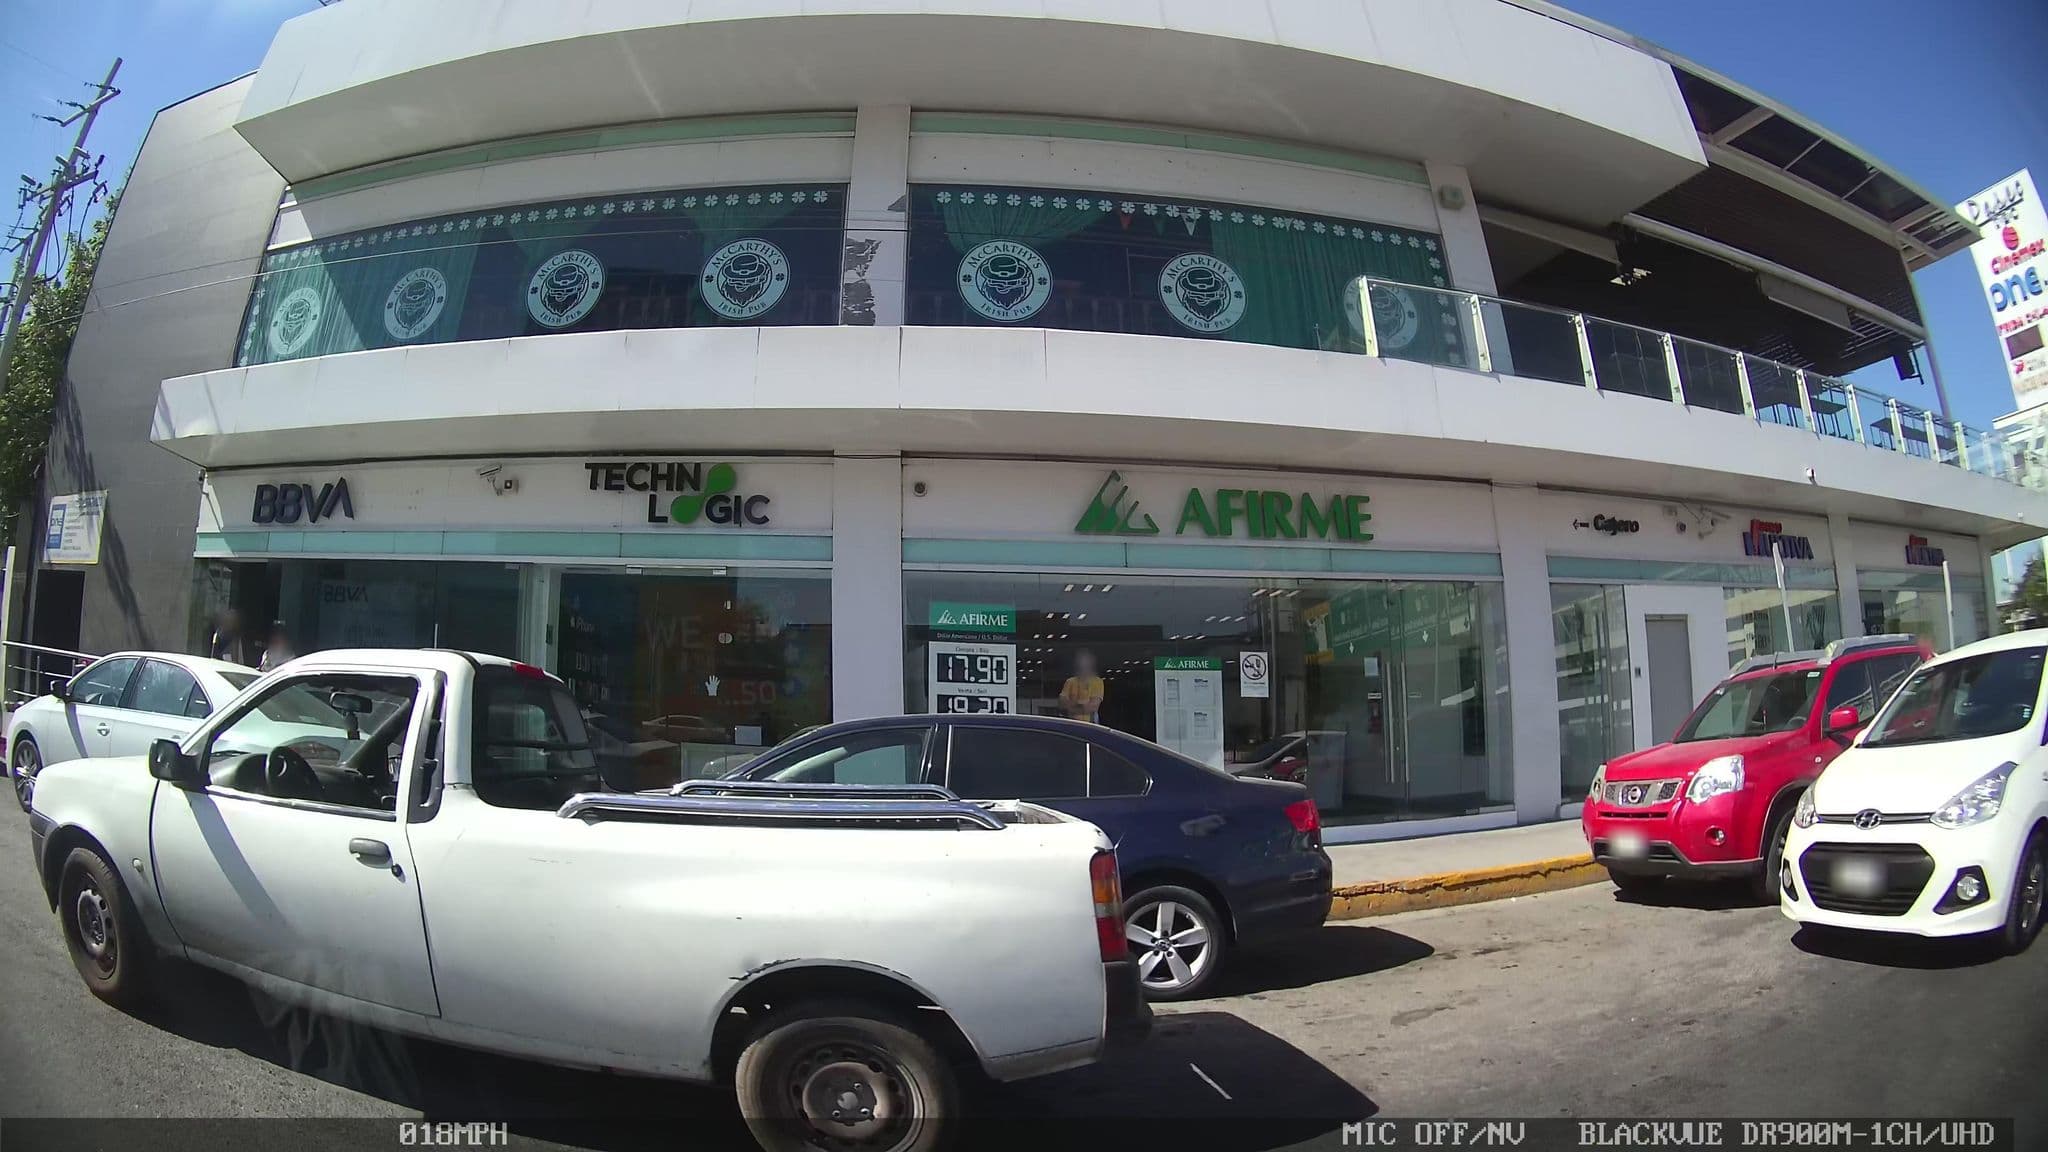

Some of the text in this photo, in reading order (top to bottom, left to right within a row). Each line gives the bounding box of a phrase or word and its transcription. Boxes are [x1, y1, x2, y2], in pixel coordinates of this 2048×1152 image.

[252, 477, 354, 524] BBVA
[1176, 487, 1374, 541] AFIRME
[959, 613, 1008, 627] AFIRME
[948, 655, 1007, 683] 17.90
[1179, 660, 1209, 669] AFIRME
